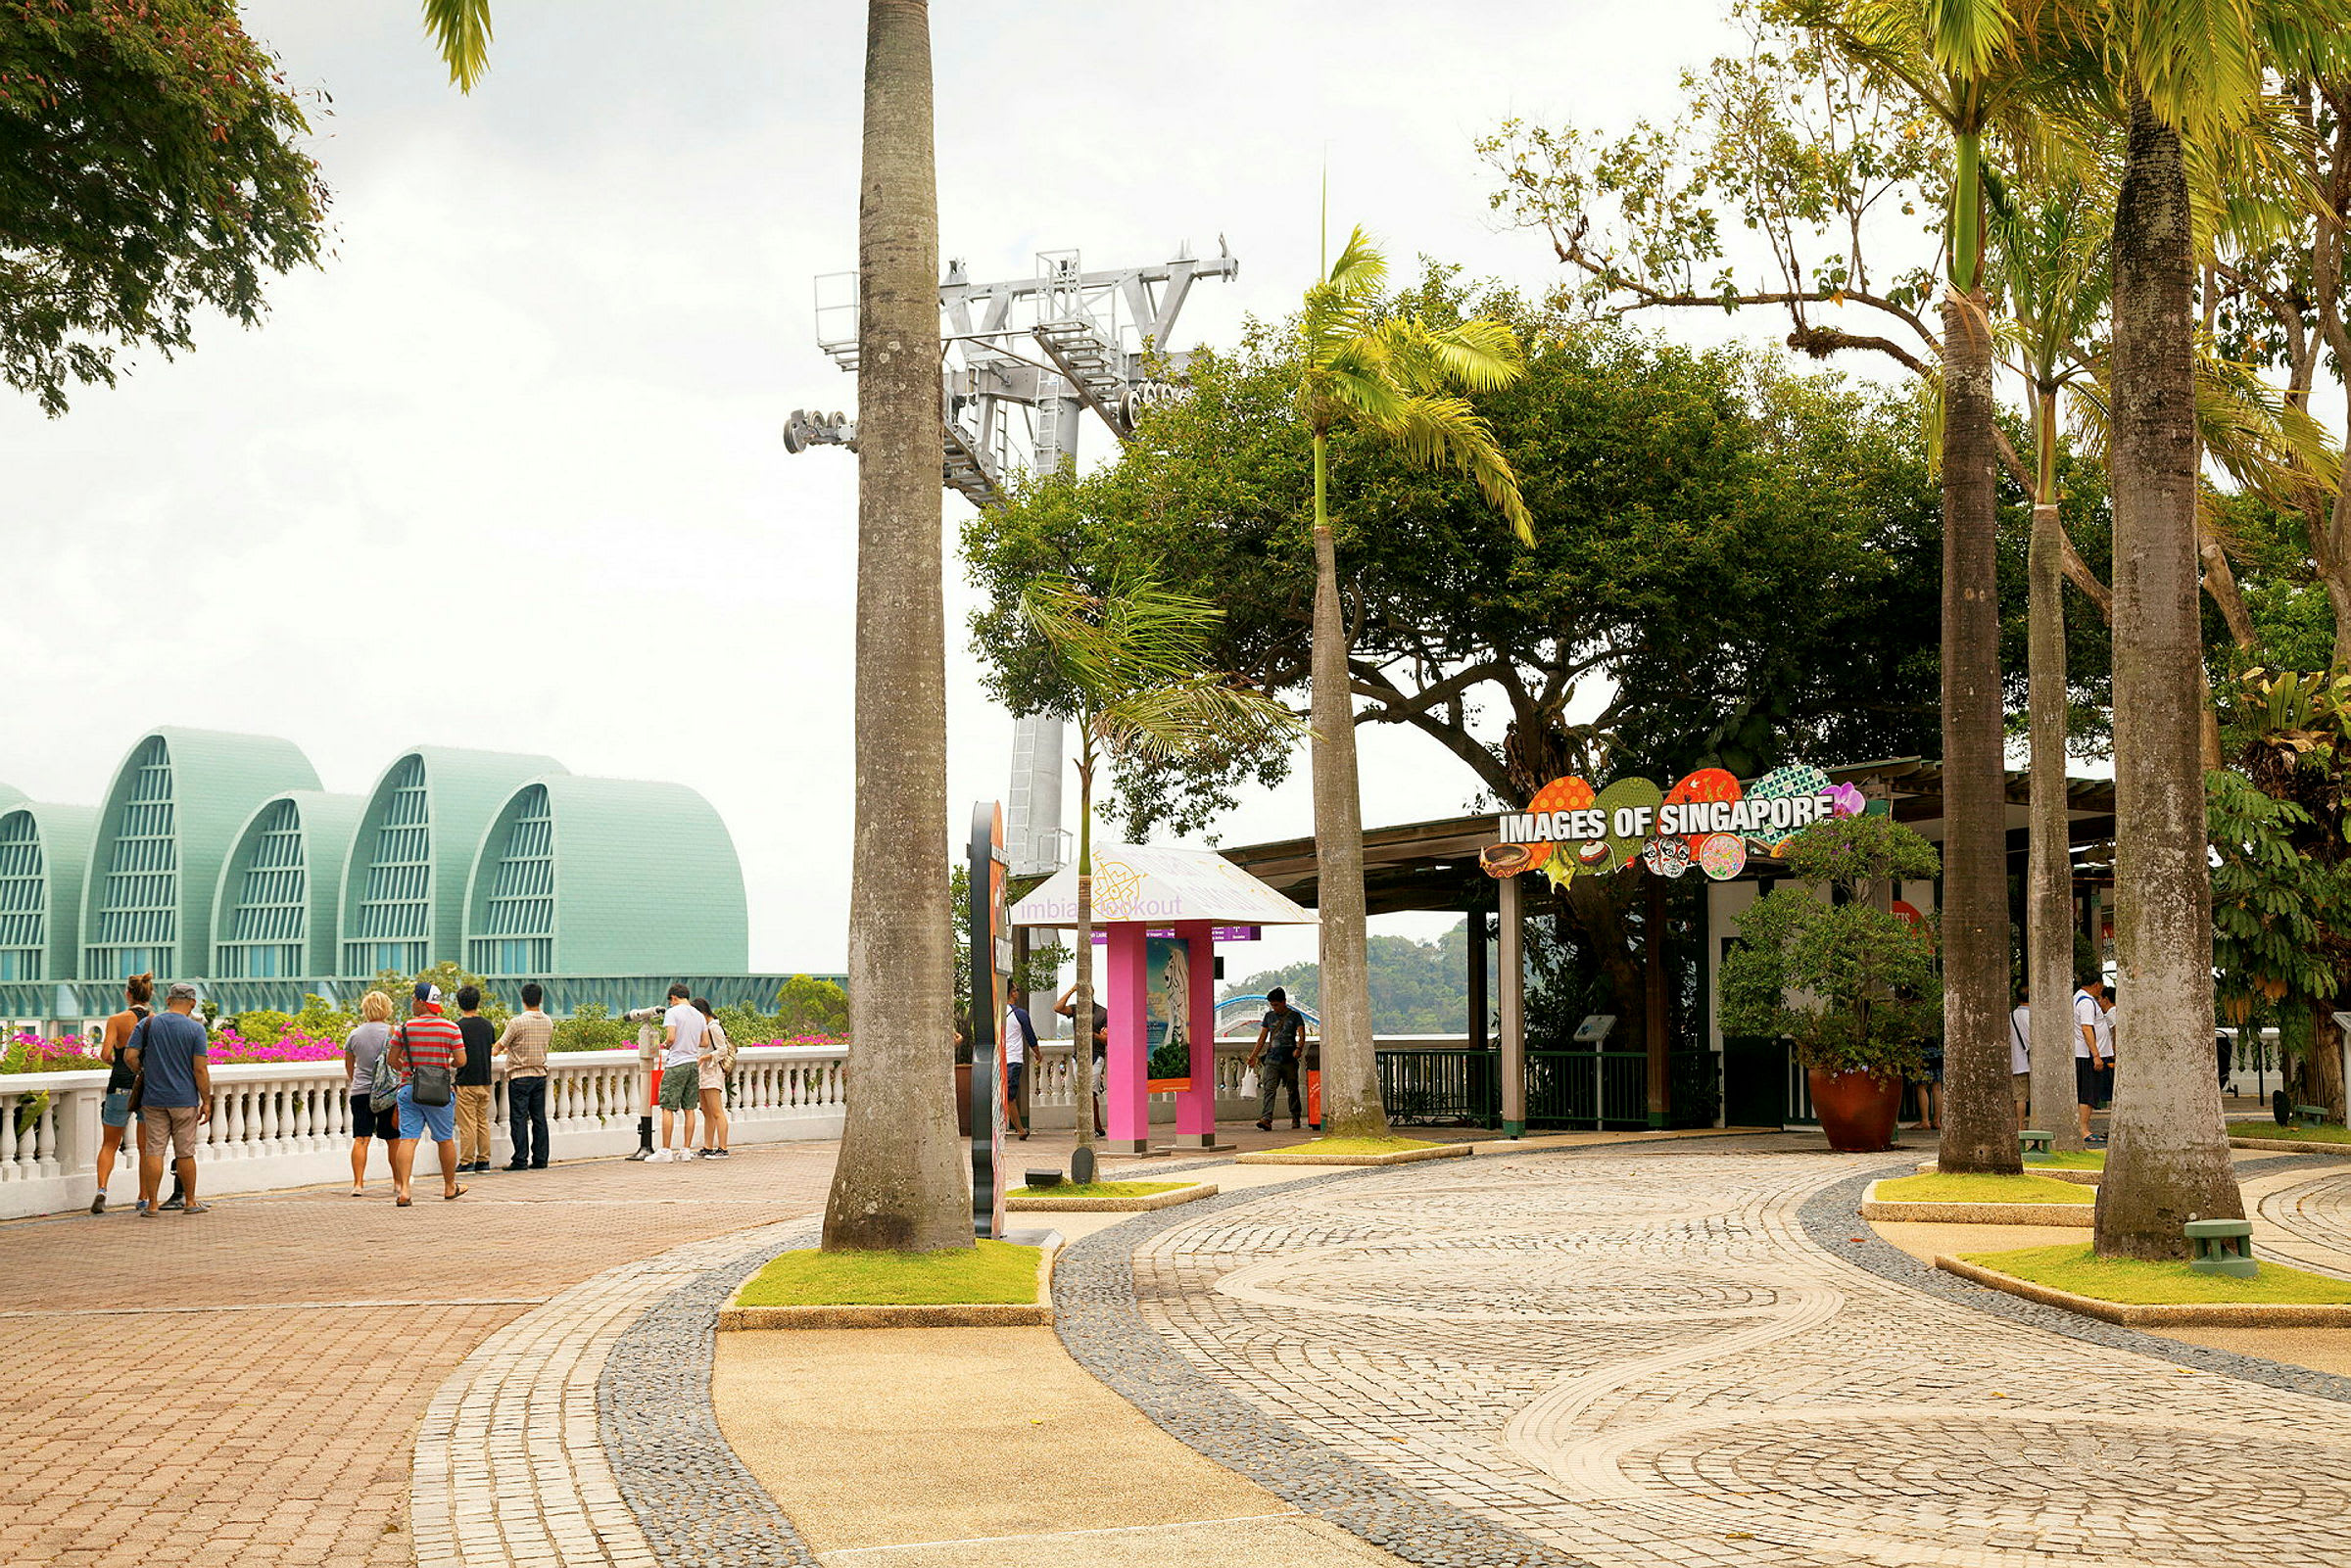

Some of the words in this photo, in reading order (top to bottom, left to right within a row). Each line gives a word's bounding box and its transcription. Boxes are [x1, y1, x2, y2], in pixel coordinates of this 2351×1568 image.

[1499, 809, 1607, 844] IMAGES
[1614, 806, 1653, 837] OF
[1659, 794, 1835, 835] SINGAPORE
[1100, 895, 1183, 917] lookout
